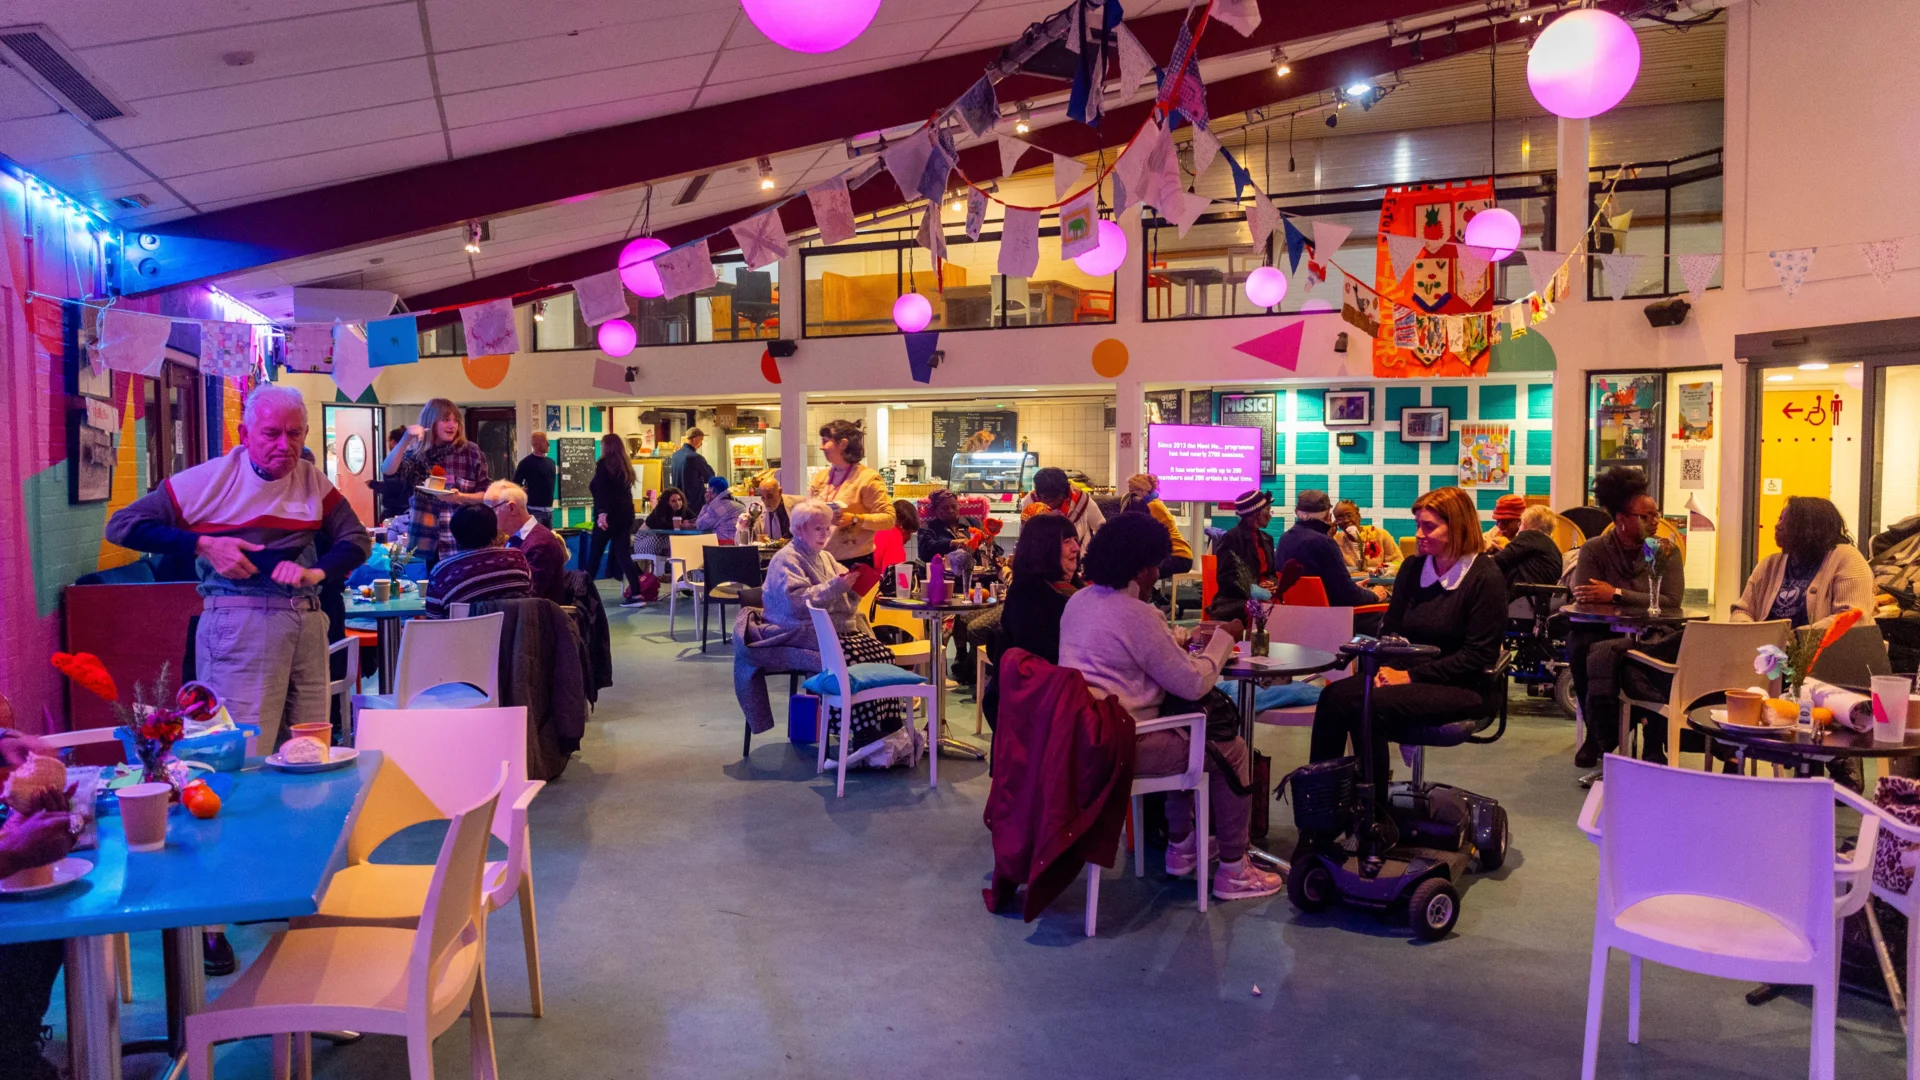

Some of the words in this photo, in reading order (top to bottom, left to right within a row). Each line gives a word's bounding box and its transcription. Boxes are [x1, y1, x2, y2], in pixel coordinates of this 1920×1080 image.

[1376, 246, 1406, 367] LAVOURS
[1162, 401, 1177, 410] TIMES
[1224, 398, 1273, 413] MUSIC!
